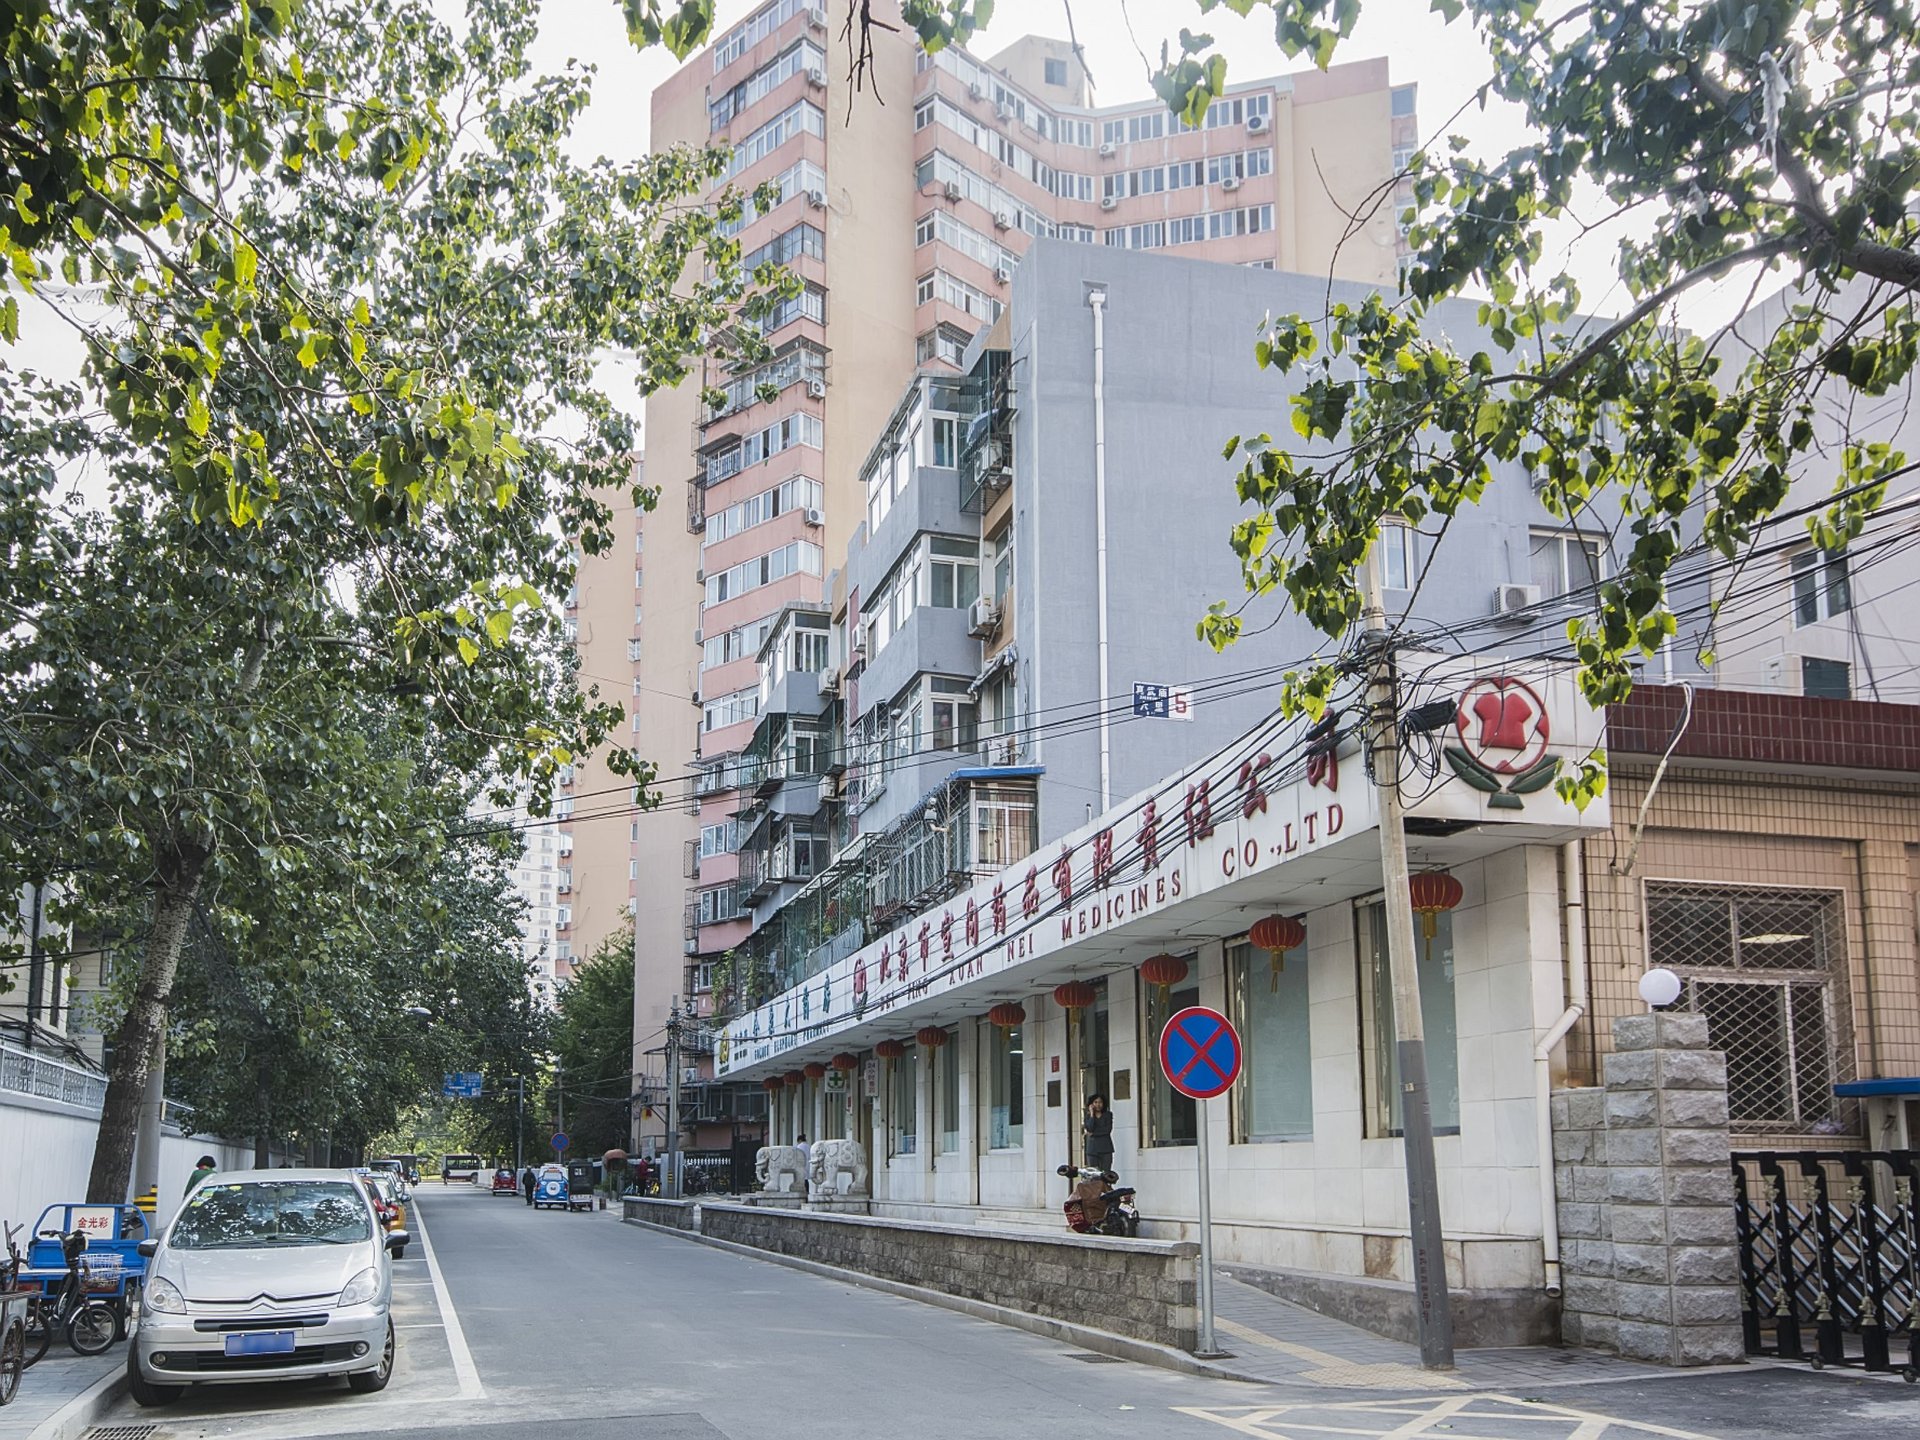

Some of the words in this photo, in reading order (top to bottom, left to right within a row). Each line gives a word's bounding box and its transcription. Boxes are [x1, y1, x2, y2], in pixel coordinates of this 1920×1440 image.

[1175, 692, 1186, 713] 5
[1008, 932, 1034, 962] NEI
[1061, 868, 1182, 941] MEDICINES
[77, 1216, 109, 1229] 金光彩
